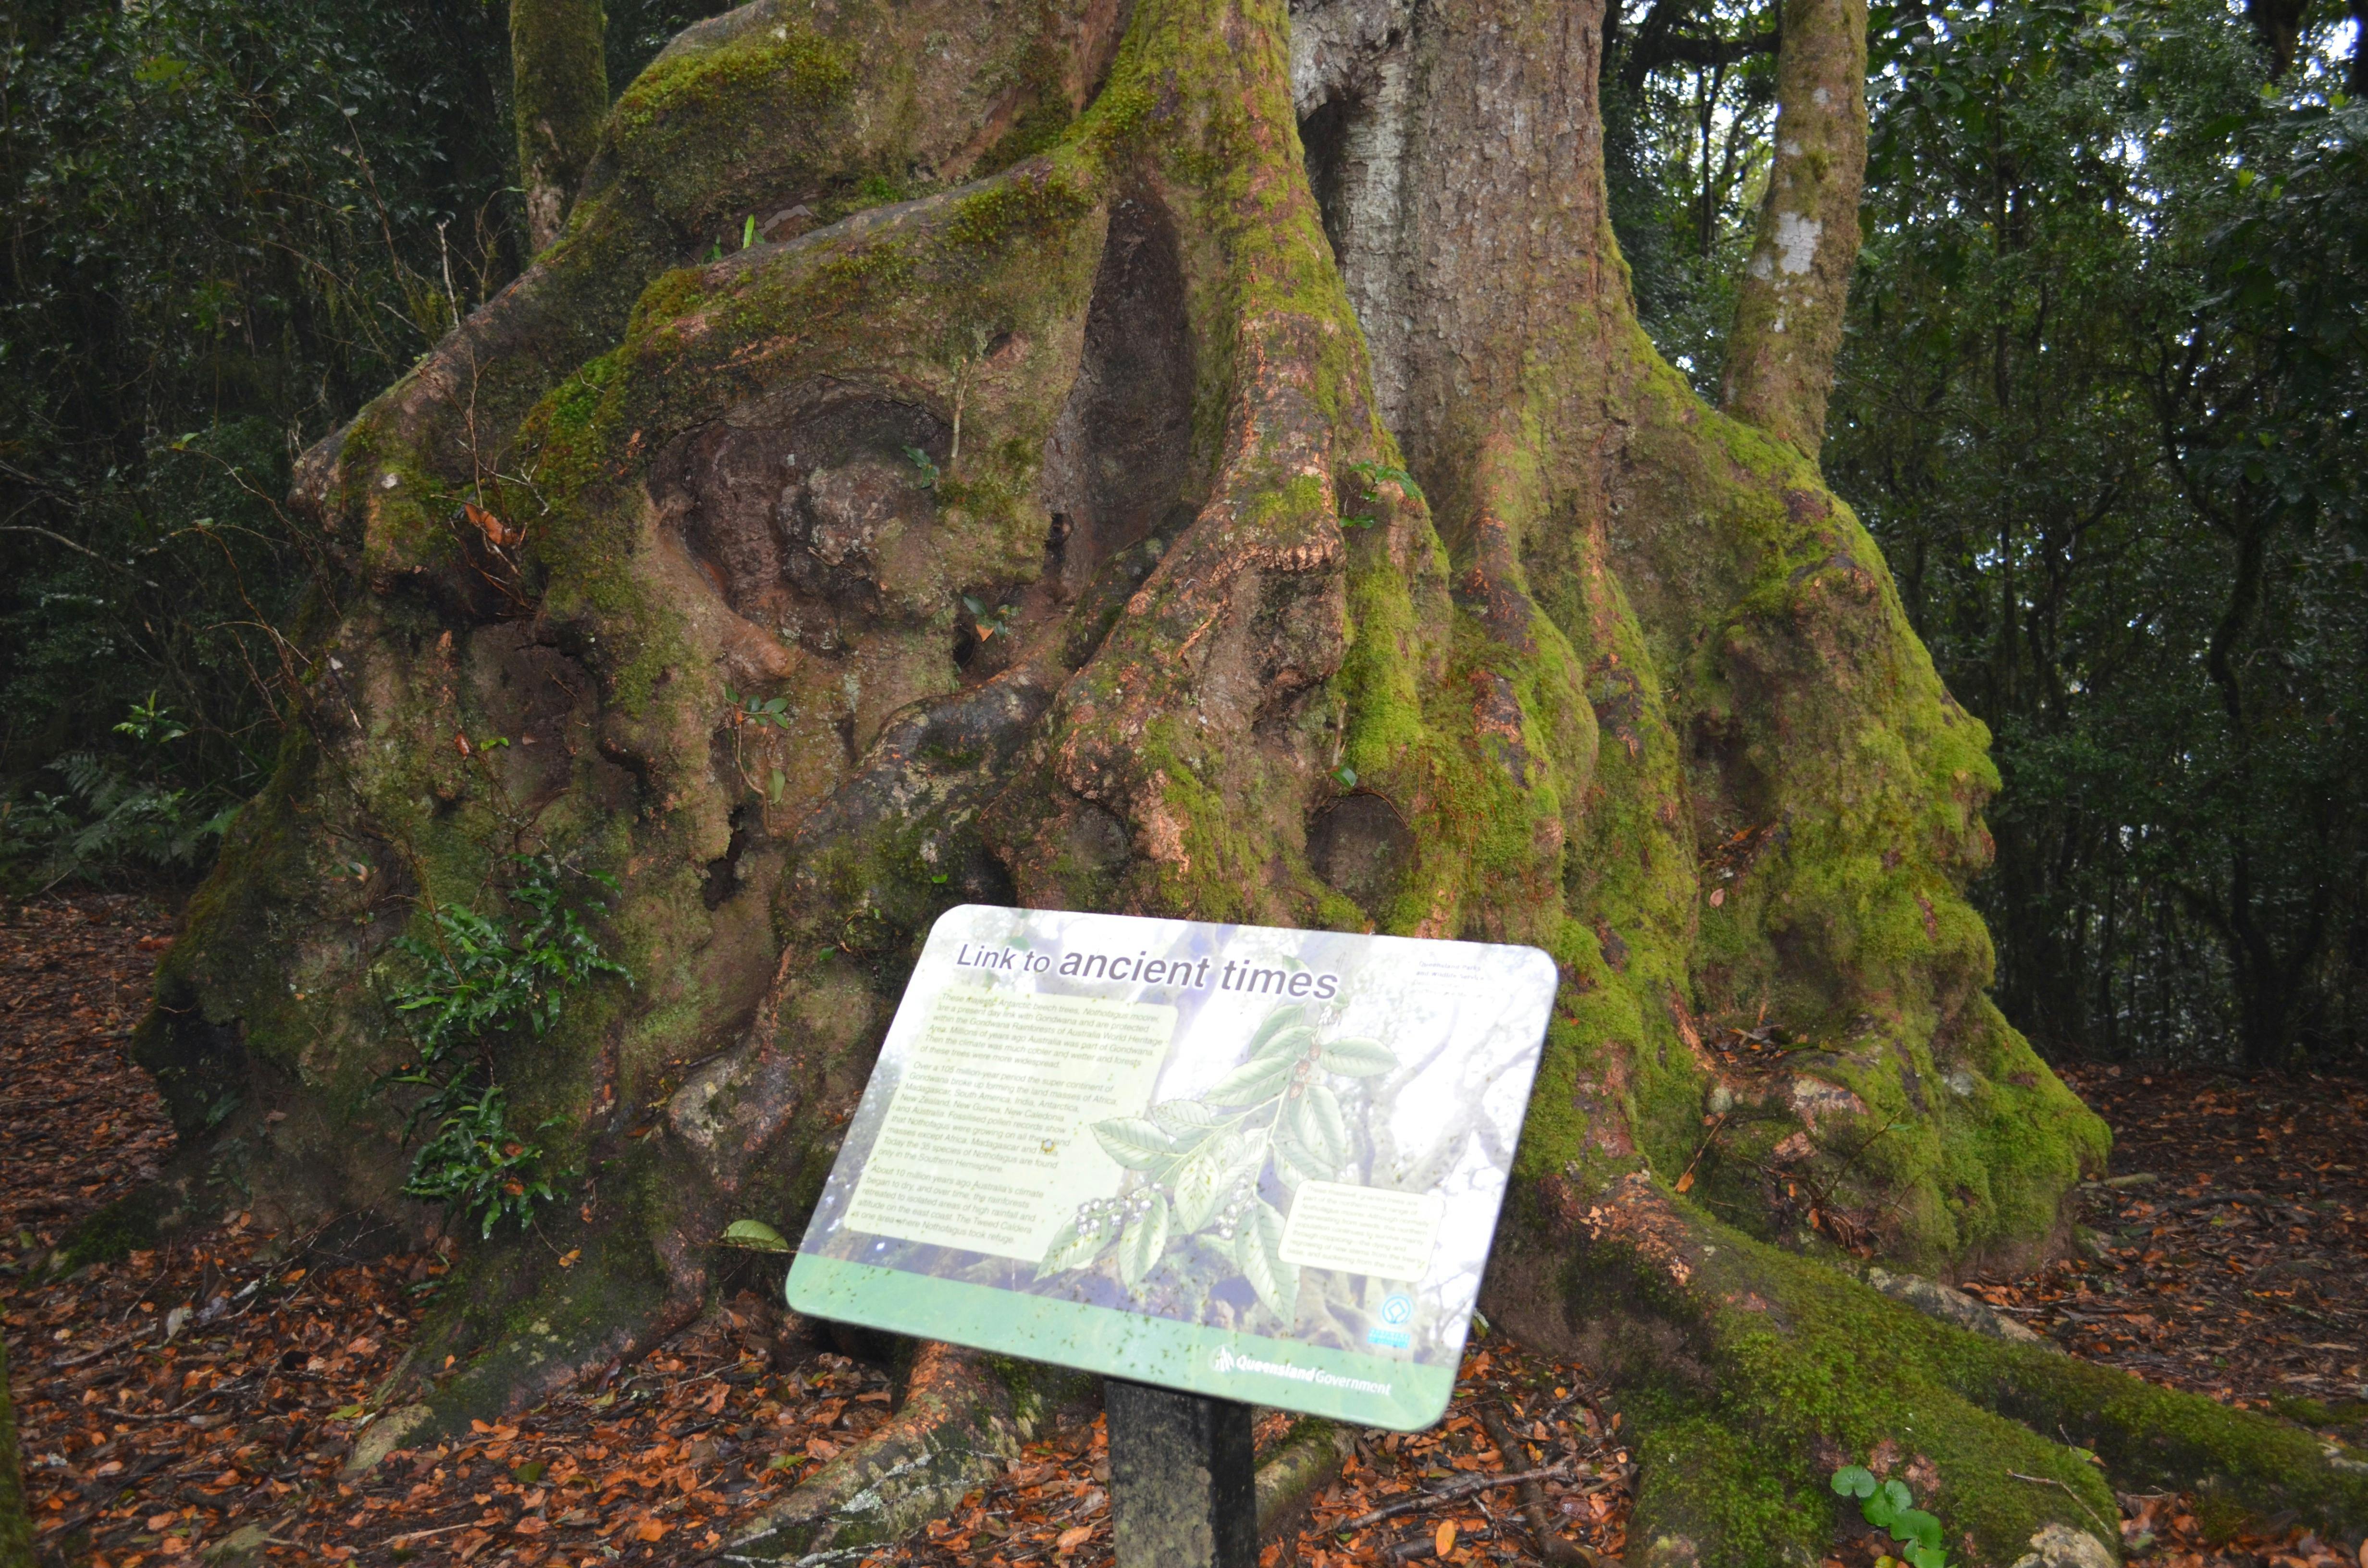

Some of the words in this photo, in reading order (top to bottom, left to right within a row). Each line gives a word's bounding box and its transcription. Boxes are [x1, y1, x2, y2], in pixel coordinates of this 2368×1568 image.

[955, 943, 1019, 969] Link
[1021, 951, 1052, 973] to
[1057, 952, 1213, 988] ancient
[1218, 960, 1341, 1000] times
[940, 993, 965, 1002] These
[998, 999, 1032, 1009] Antarctic
[1032, 1002, 1058, 1011] beech
[1082, 1007, 1129, 1019] Nothofagus
[956, 1006, 987, 1015] present
[987, 1008, 1001, 1018] day
[1002, 1010, 1017, 1018] link
[1034, 1013, 1078, 1025] Gondwana
[1110, 1022, 1150, 1032] protected
[932, 1014, 955, 1023] within
[955, 1016, 969, 1024] the
[968, 1017, 1011, 1029] Gondwana
[1011, 1022, 1056, 1033] Rainforests
[1066, 1028, 1102, 1039] Australia
[1102, 1031, 1128, 1041] World
[1127, 1034, 1164, 1046] Heritage
[949, 1026, 979, 1036] Millions
[1010, 1034, 1027, 1042] ago
[1027, 1035, 1062, 1045] Australia
[1080, 1042, 1098, 1050] part
[924, 1034, 944, 1043] Then
[944, 1037, 958, 1045] the
[958, 1039, 986, 1048] climate
[1003, 1044, 1027, 1053] much
[1026, 1047, 1052, 1055] cooler
[1070, 1052, 1095, 1061] wetter
[1113, 1055, 1143, 1066] forests
[928, 1046, 950, 1055] these
[950, 1049, 971, 1058] trees
[971, 1052, 991, 1060] were
[991, 1054, 1013, 1063] more
[908, 1072, 950, 1084] Gondwana
[950, 1077, 973, 1087] broke
[973, 1081, 985, 1090] up
[985, 1081, 1015, 1094] forming
[1015, 1085, 1030, 1094] the
[1030, 1087, 1049, 1096] land
[1048, 1090, 1082, 1101] masses
[912, 1062, 932, 1071] Over
[940, 1065, 955, 1074] 105
[999, 1073, 1027, 1082] period
[1026, 1075, 1041, 1084] the
[1041, 1078, 1065, 1088] super
[1065, 1081, 1104, 1091] continent
[899, 1093, 917, 1102] New
[952, 1100, 971, 1109] New
[1004, 1107, 1023, 1116] New
[1024, 1109, 1065, 1122] Caledonia
[953, 1089, 978, 1099] South
[947, 1111, 987, 1123] Fossilised
[986, 1117, 1012, 1127] pollen
[1012, 1121, 1044, 1131] records
[1044, 1124, 1067, 1134] show
[877, 1149, 895, 1158] only
[894, 1150, 903, 1158] in
[903, 1151, 917, 1160] the
[917, 1153, 954, 1165] Southern
[883, 1137, 905, 1149] Today
[905, 1140, 920, 1149] the
[919, 1142, 932, 1151] 35
[931, 1145, 962, 1155] species
[972, 1149, 1018, 1164] Nothofagus
[1018, 1157, 1034, 1165] are
[1034, 1158, 1060, 1169] found
[865, 1176, 891, 1187] began
[890, 1180, 900, 1188] to
[915, 1185, 933, 1193] and
[932, 1188, 950, 1196] over
[972, 1192, 987, 1202] the
[987, 1196, 1030, 1209] rainforests
[870, 1165, 895, 1176] About
[895, 1169, 906, 1177] 10
[905, 1171, 932, 1181] million
[931, 1176, 955, 1185] years
[955, 1179, 972, 1188] ago
[972, 1180, 1014, 1194] Australia's
[1013, 1187, 1045, 1199] climate
[856, 1199, 885, 1210] altitude
[897, 1205, 912, 1214] the
[911, 1208, 930, 1217] east
[956, 1214, 972, 1224] The
[973, 1217, 1000, 1228] Tweed
[999, 1221, 1033, 1234] Caldera
[861, 1188, 897, 1200] retreated
[896, 1192, 906, 1201] to
[906, 1194, 938, 1206] isolated
[937, 1200, 962, 1210] areas
[962, 1203, 972, 1212] of
[971, 1204, 991, 1215] high
[990, 1208, 1019, 1219] rainfall
[1019, 1213, 1037, 1222] and
[1236, 1355, 1315, 1382] Queensland
[1317, 1370, 1392, 1395] Government
